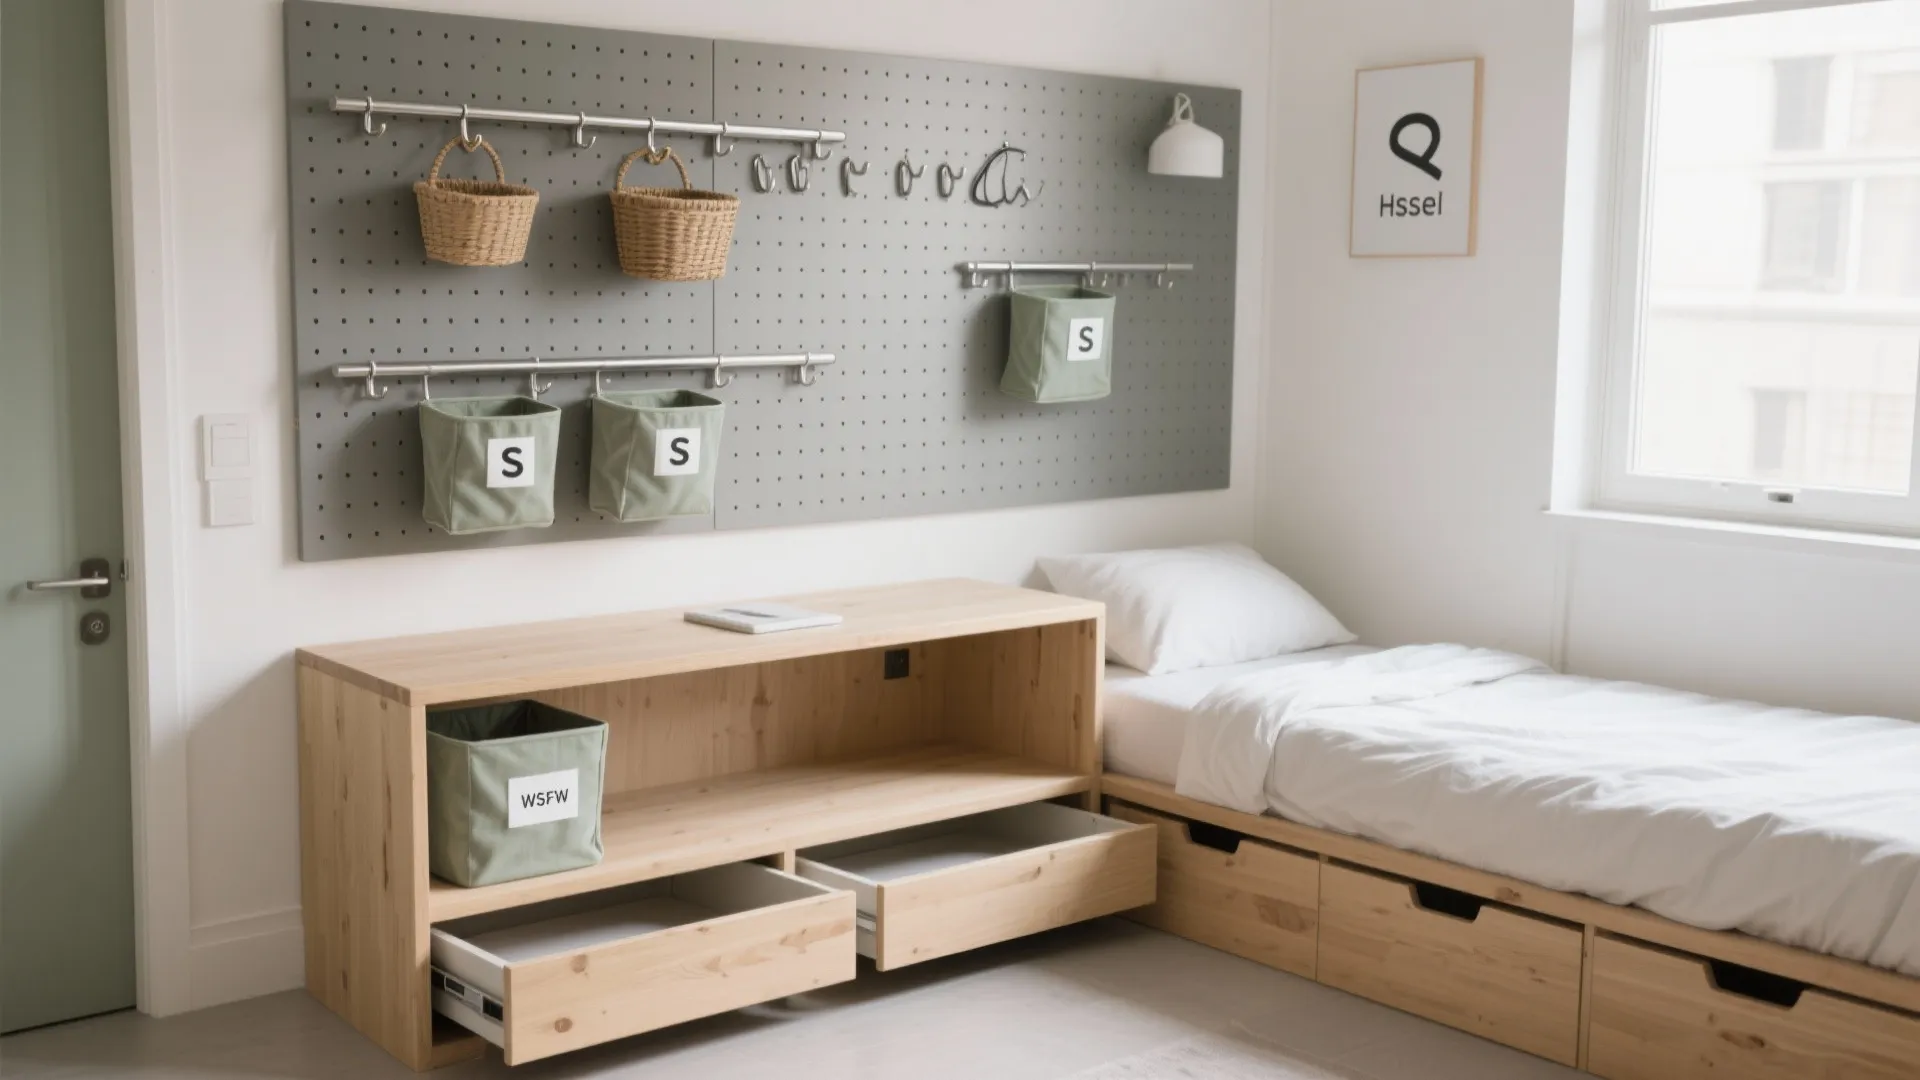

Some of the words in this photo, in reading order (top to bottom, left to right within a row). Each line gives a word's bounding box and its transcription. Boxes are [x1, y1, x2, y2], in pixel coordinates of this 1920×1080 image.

[1379, 191, 1443, 218] Hssel
[1078, 325, 1094, 353] S
[501, 446, 524, 478] S
[669, 436, 690, 466] S
[521, 788, 569, 809] WSFW
